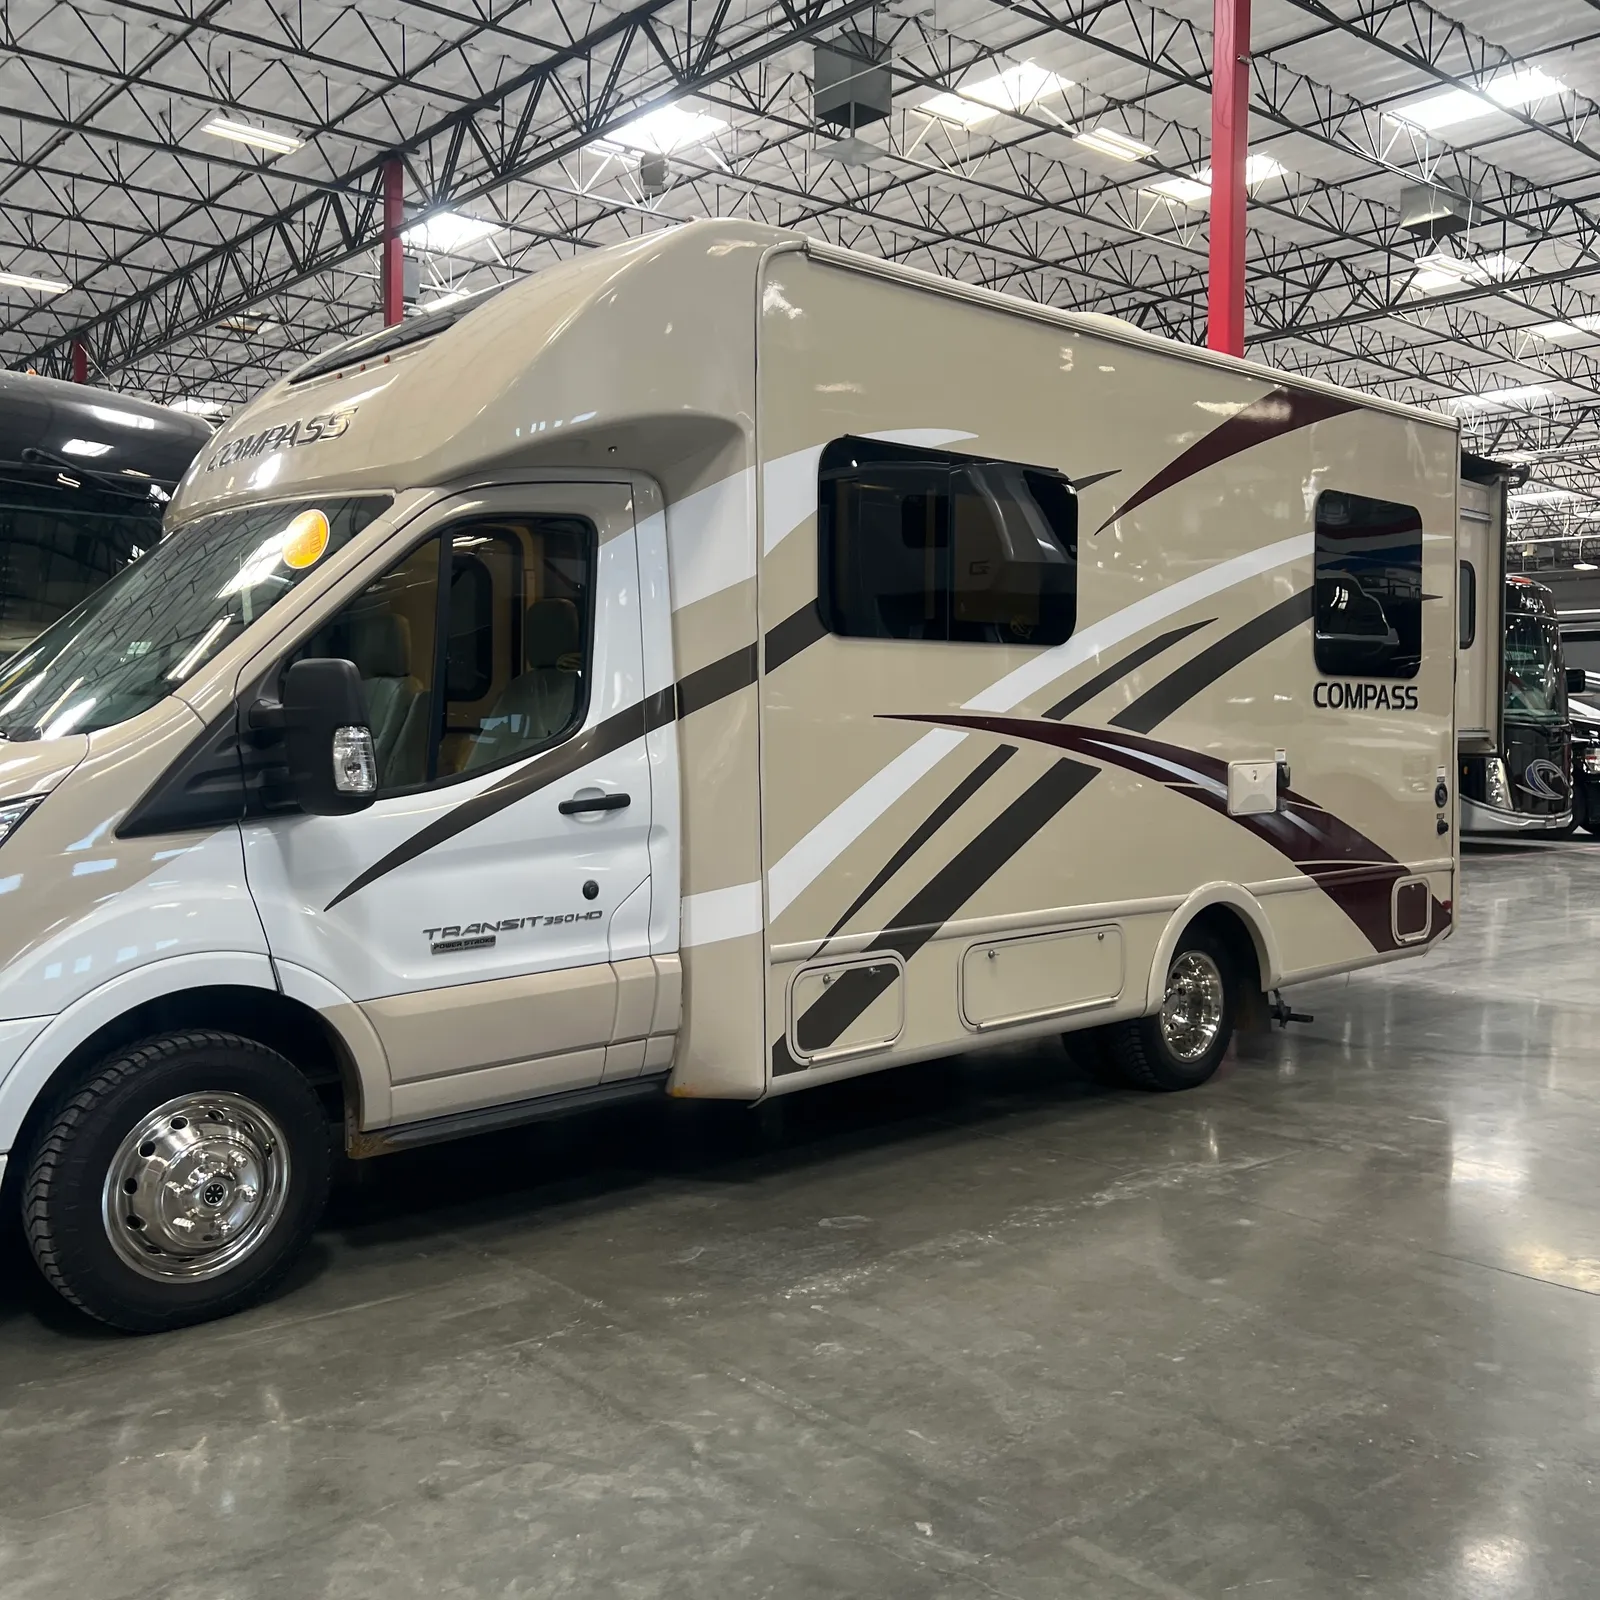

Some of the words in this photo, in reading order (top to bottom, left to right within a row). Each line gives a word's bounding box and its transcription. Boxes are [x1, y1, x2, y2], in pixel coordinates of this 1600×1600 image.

[205, 406, 358, 473] COMPASS
[1313, 682, 1419, 710] COMPASS
[423, 915, 543, 940] TRANSIT
[433, 942, 462, 950] POWER
